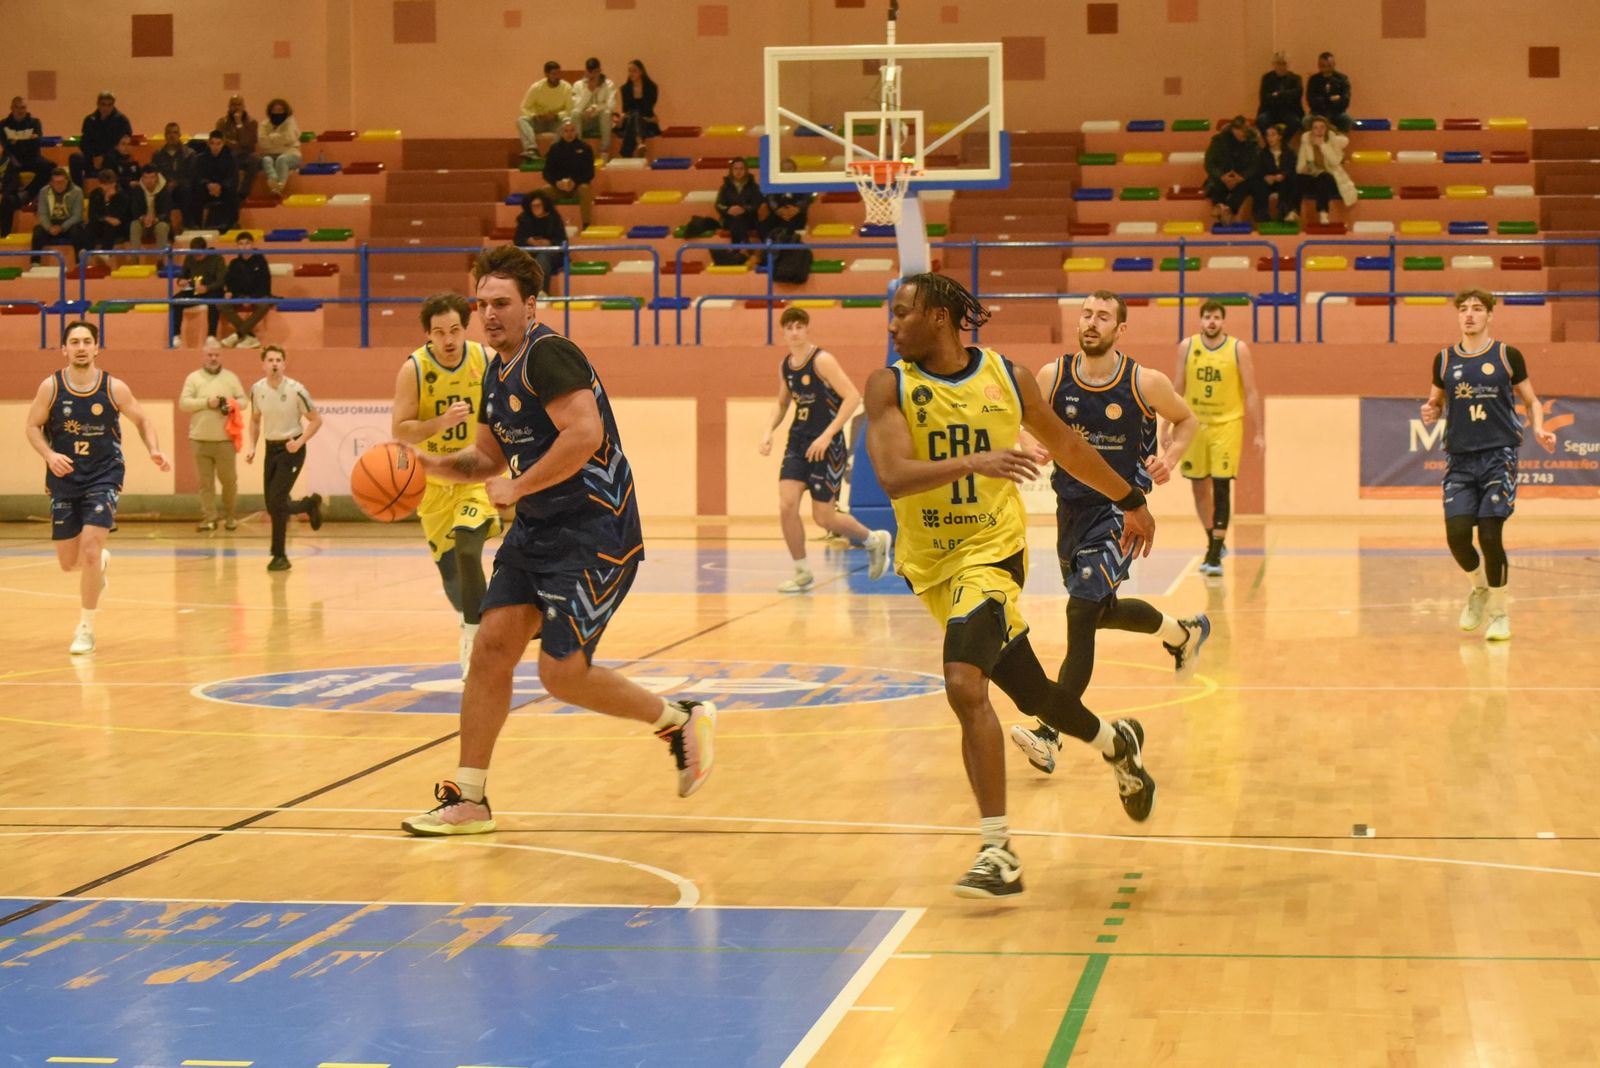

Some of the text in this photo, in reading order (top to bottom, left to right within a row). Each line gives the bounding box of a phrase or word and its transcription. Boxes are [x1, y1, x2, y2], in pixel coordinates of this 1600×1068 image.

[1196, 366, 1222, 383] CBA
[1204, 384, 1213, 398] 9
[1469, 403, 1487, 422] 14
[442, 421, 468, 441] 30
[73, 440, 90, 456] 12
[1532, 472, 1554, 484] 743
[460, 505, 478, 518] 30
